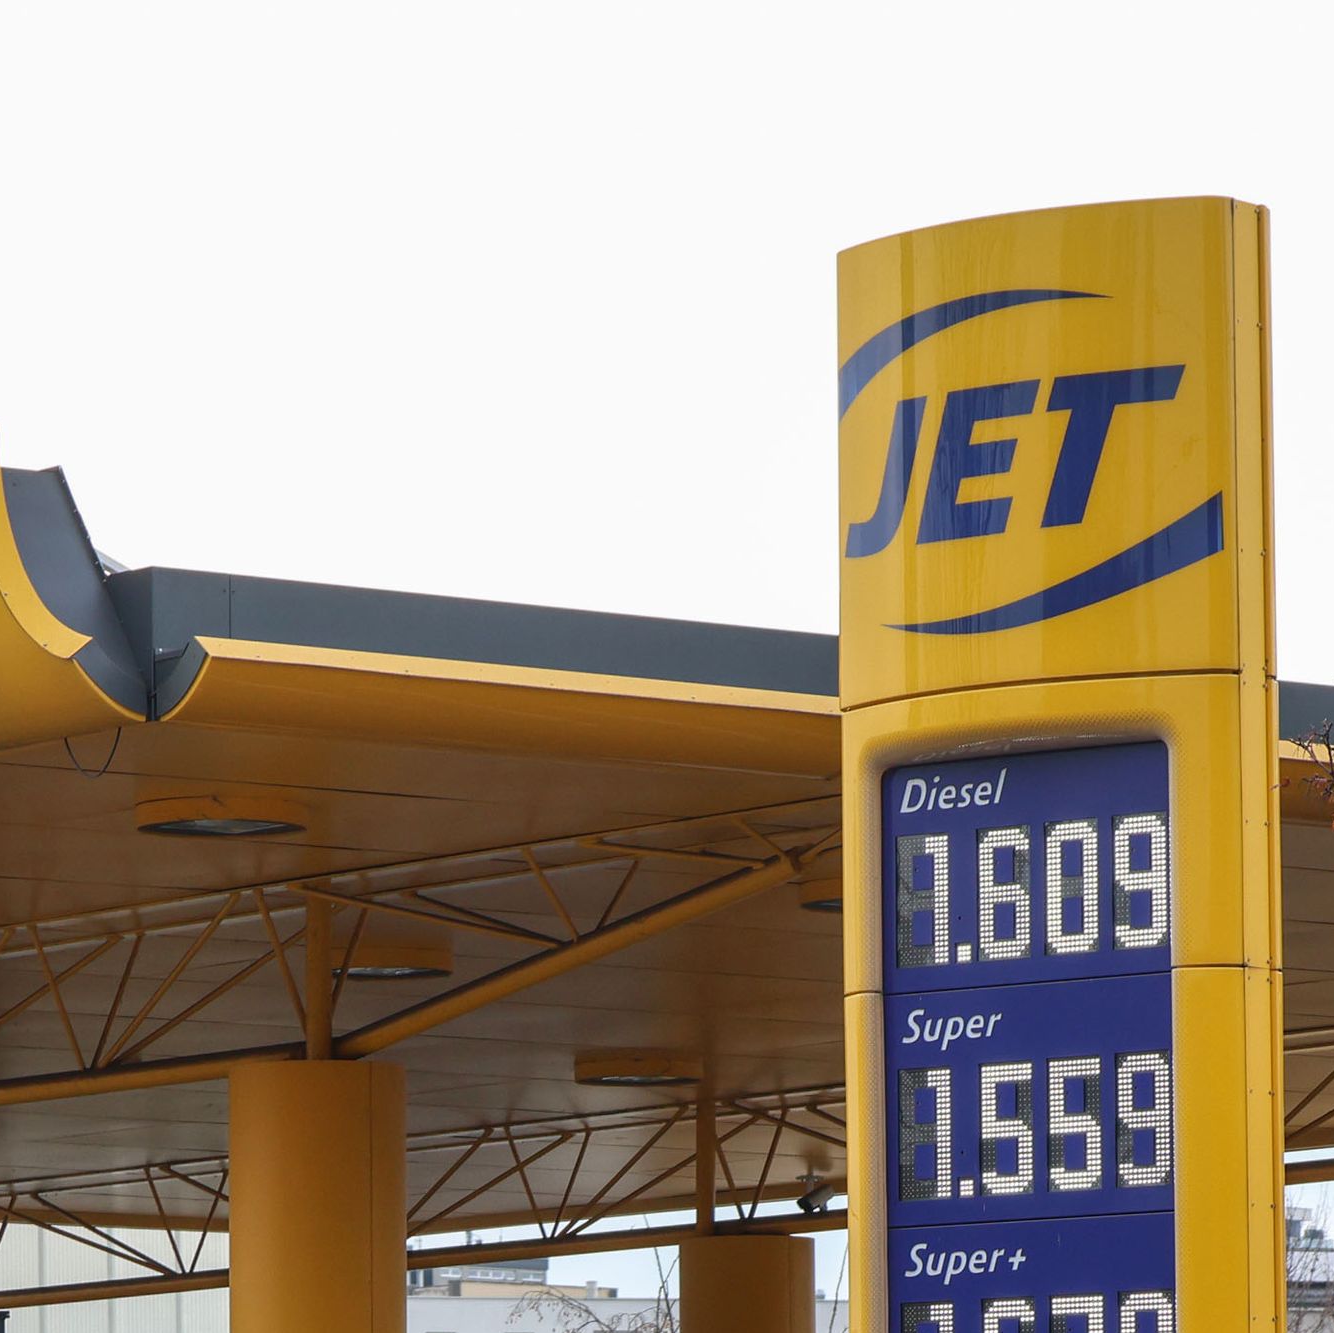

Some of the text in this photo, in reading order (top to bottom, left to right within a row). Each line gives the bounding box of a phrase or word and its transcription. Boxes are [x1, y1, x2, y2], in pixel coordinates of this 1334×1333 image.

[845, 364, 1186, 558] JET
[900, 768, 1008, 814] Diesel
[925, 813, 1168, 965] 1.609
[902, 1009, 1003, 1051] Super
[927, 1053, 1171, 1199] 1.559
[904, 1243, 1028, 1286] Super+
